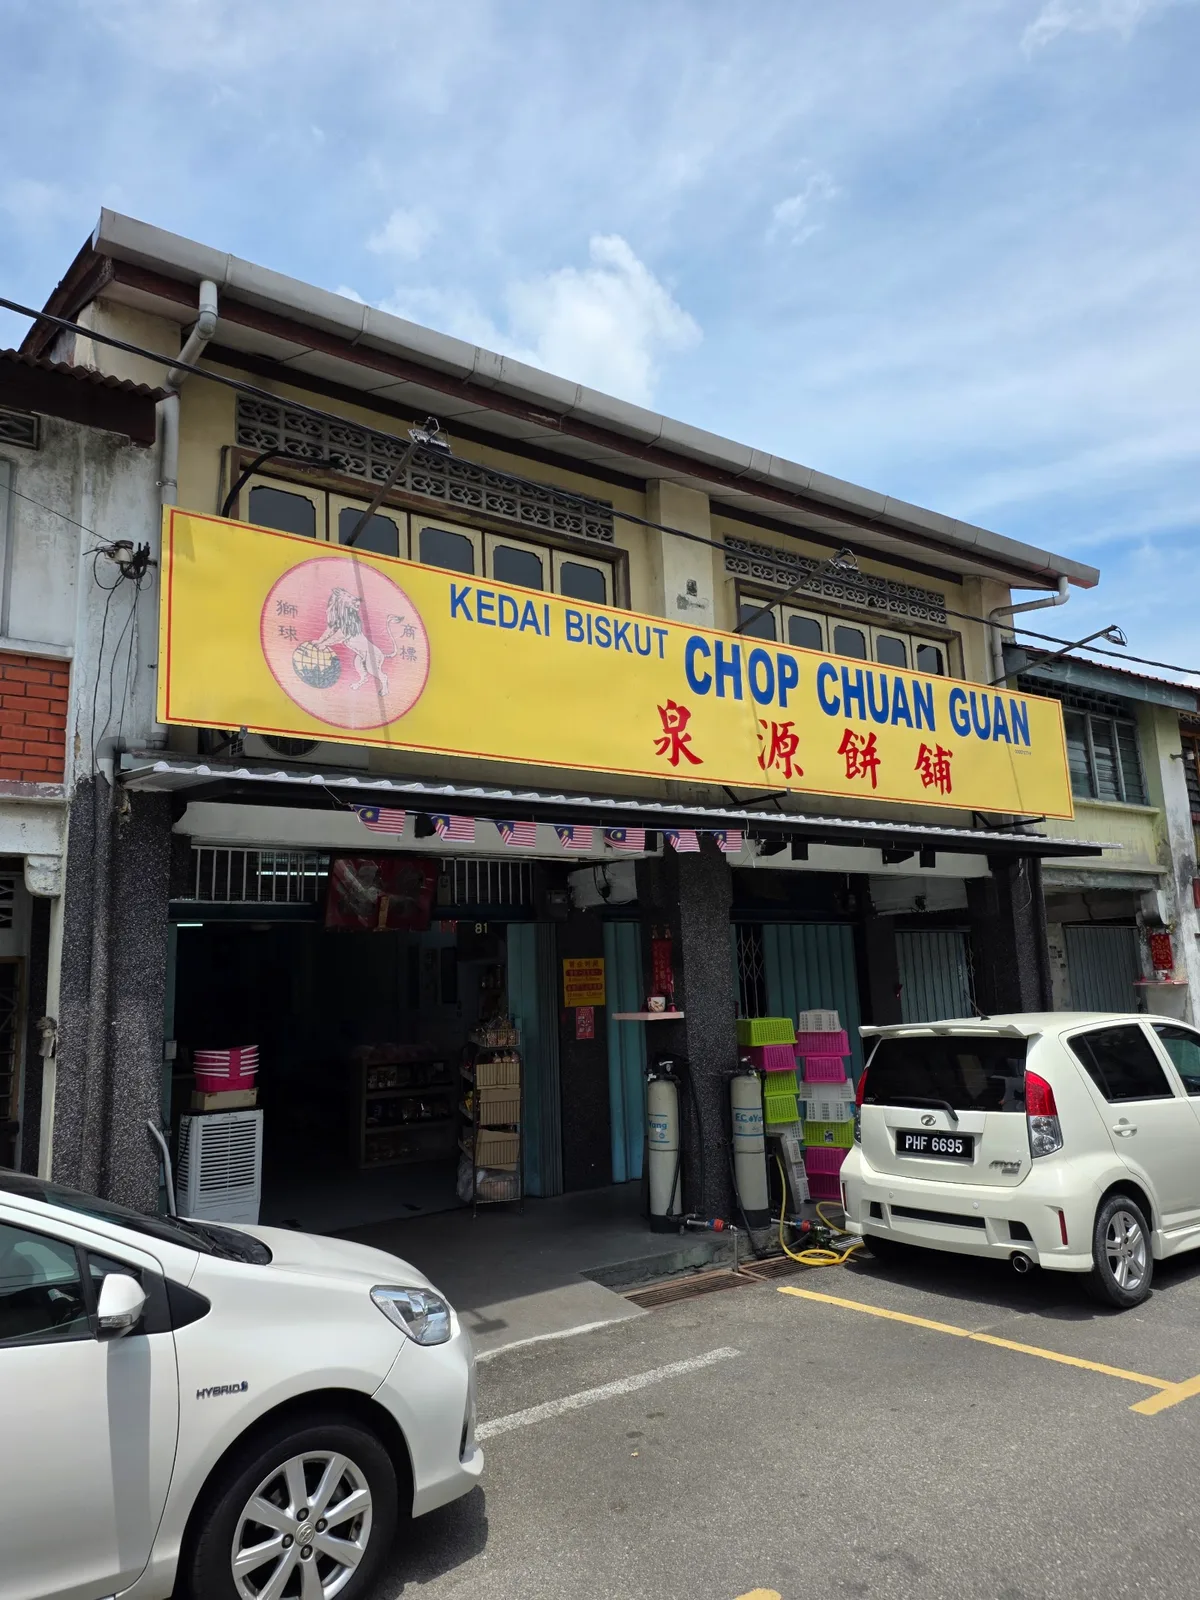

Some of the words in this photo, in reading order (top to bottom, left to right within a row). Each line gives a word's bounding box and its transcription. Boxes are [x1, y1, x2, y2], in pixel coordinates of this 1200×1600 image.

[400, 623, 418, 662] 商標
[452, 585, 550, 635] KEDAI
[565, 609, 667, 657] BISKUT
[685, 636, 799, 708] CHOP
[817, 662, 936, 731] CHUAN
[949, 687, 1031, 746] GUAN
[475, 922, 488, 934] 81
[905, 1135, 928, 1150] PHF
[931, 1137, 963, 1153] 6695
[196, 1383, 240, 1400] HYBRID
